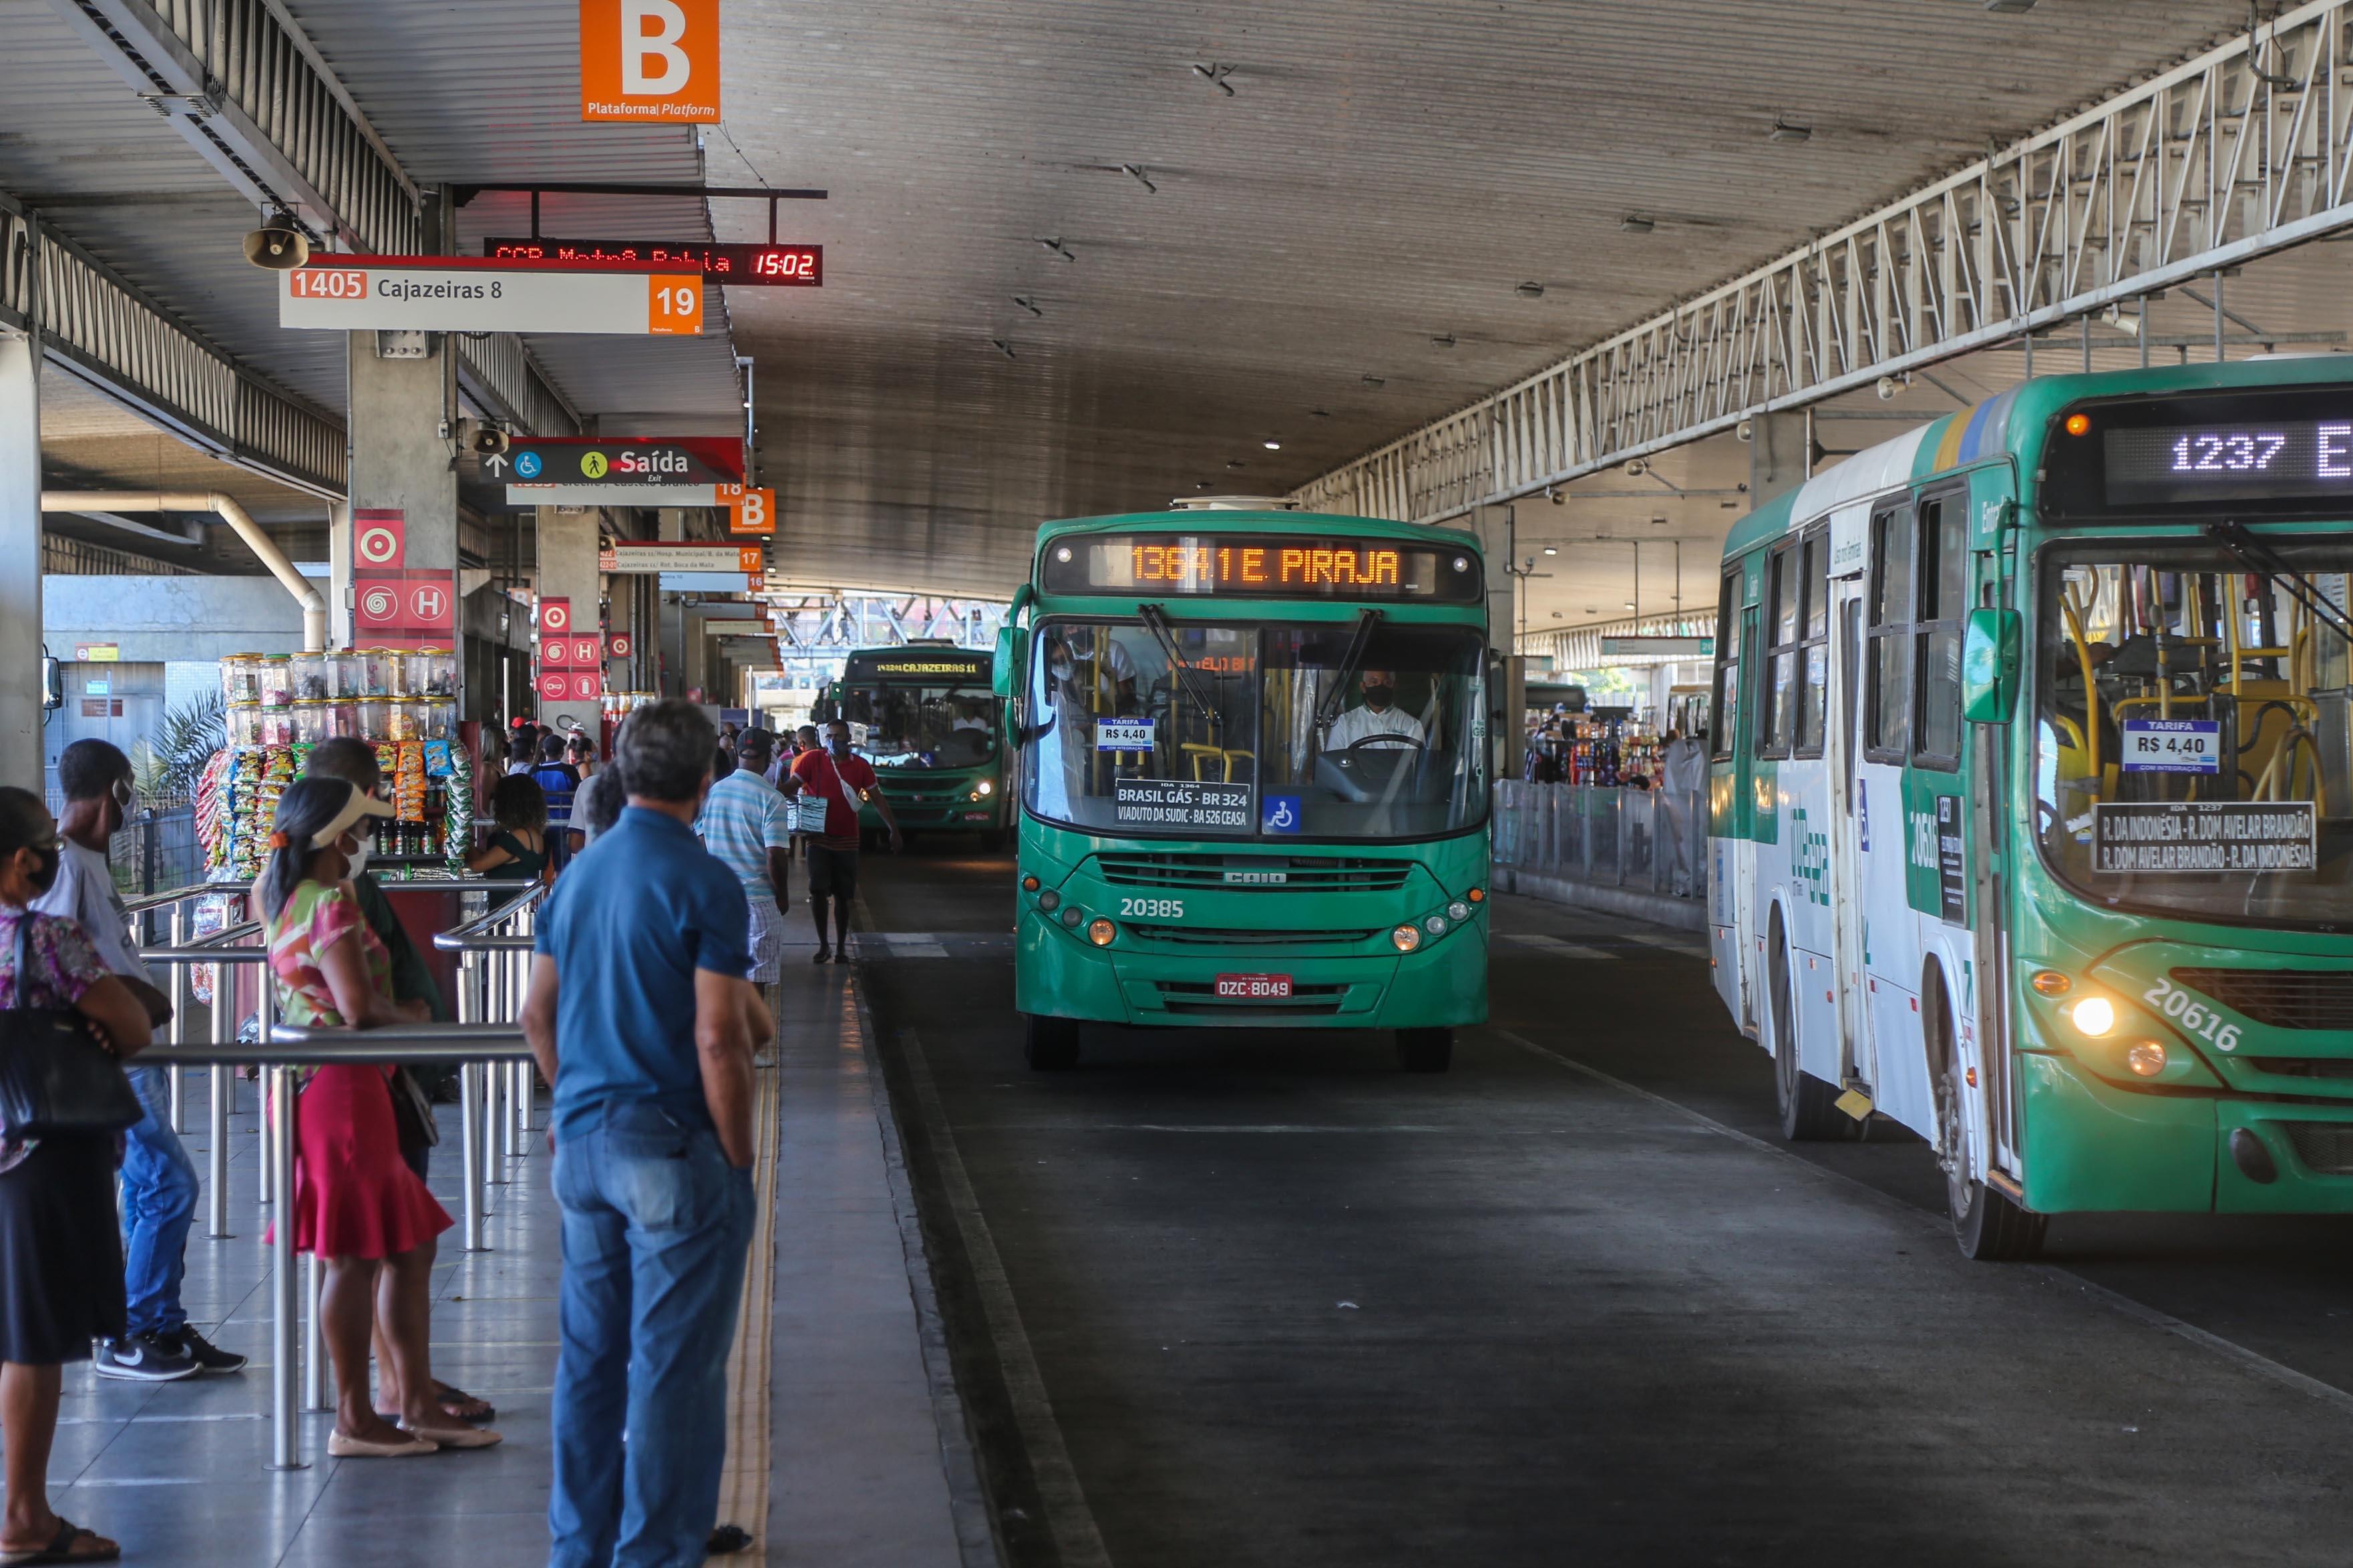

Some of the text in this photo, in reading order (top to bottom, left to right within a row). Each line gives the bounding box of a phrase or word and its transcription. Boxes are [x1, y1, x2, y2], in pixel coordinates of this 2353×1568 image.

[621, 0, 690, 95] B
[588, 102, 715, 117] Plataforma Platform
[757, 254, 813, 275] 15:02
[296, 272, 502, 301] 1405 Cajazeiras 8
[657, 287, 695, 315] 19
[2173, 425, 2352, 477] 1237 E
[620, 450, 689, 473] Saída
[648, 474, 662, 483] Exit
[720, 483, 741, 496] 18
[742, 493, 765, 525] B
[1982, 495, 2004, 534] Entra
[616, 550, 647, 558] Cajazeiras
[742, 552, 758, 564] 17
[617, 561, 647, 569] Cajazeiras
[1132, 546, 1230, 582] 1364.1
[1282, 549, 1398, 584] PIRAJA
[749, 577, 762, 586] 16
[1106, 729, 1146, 740] R$ 4,40
[2148, 721, 2194, 731] TARIFA
[2138, 737, 2205, 755] R$ 4,40
[1118, 789, 1164, 803] BRASIL
[1167, 789, 1193, 804] GÁS
[1202, 792, 1220, 806] BR
[1222, 793, 1248, 807] 324
[1118, 806, 1152, 821] VIADUTO
[1153, 807, 1164, 821] DA
[1165, 807, 1189, 823] SUDIC
[1194, 809, 1205, 823] BA
[1206, 810, 1221, 824] 526
[1222, 811, 1246, 826] CEASA
[2103, 816, 2113, 841] R.
[2114, 816, 2128, 840] DA
[2129, 813, 2182, 840] INDONÉSIA
[2188, 815, 2198, 840] R.
[2199, 815, 2222, 840] DOM
[2223, 815, 2261, 839] AVELAR
[2262, 810, 2310, 839] BRANDÃO
[1910, 811, 1938, 870] 20616
[2103, 847, 2113, 869] R.
[2114, 846, 2137, 869] DOM
[2138, 846, 2175, 869] AVELAR
[2177, 842, 2225, 868] BRANDÃO
[2231, 845, 2241, 867] R.
[2242, 845, 2257, 867] DA
[2257, 841, 2312, 867] INDONÉSIA
[1225, 872, 1286, 884] CAIO
[1120, 898, 1184, 918] 20385
[2143, 977, 2243, 1052] 20616
